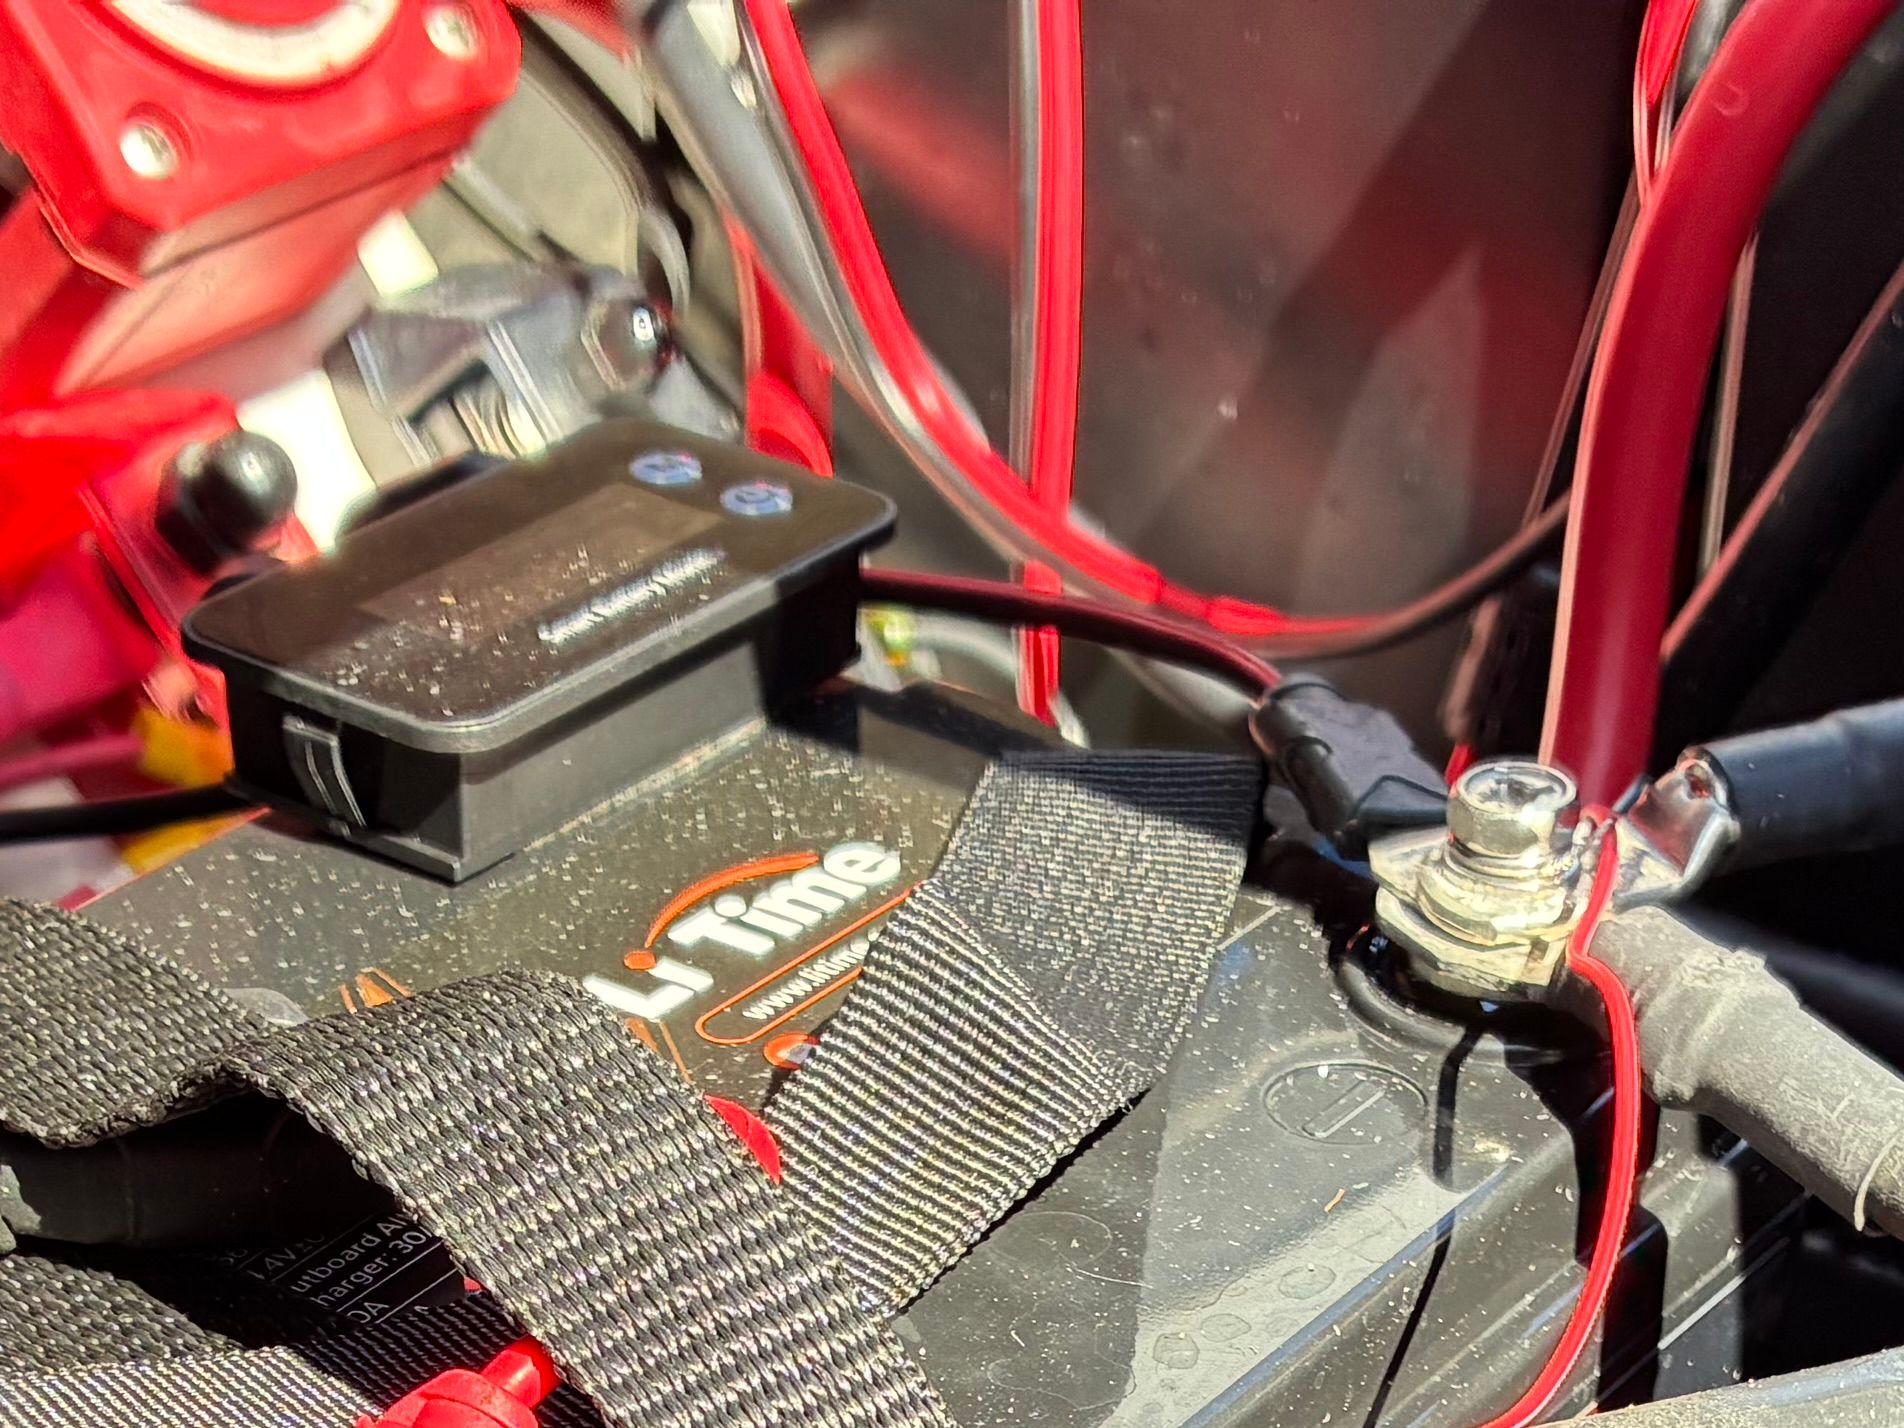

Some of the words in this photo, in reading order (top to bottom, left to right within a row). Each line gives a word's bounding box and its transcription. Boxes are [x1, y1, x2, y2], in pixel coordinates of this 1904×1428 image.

[583, 950, 715, 1022] Li
[667, 841, 902, 957] Time
[290, 1231, 380, 1294] utboard
[310, 1252, 397, 1308] harger:
